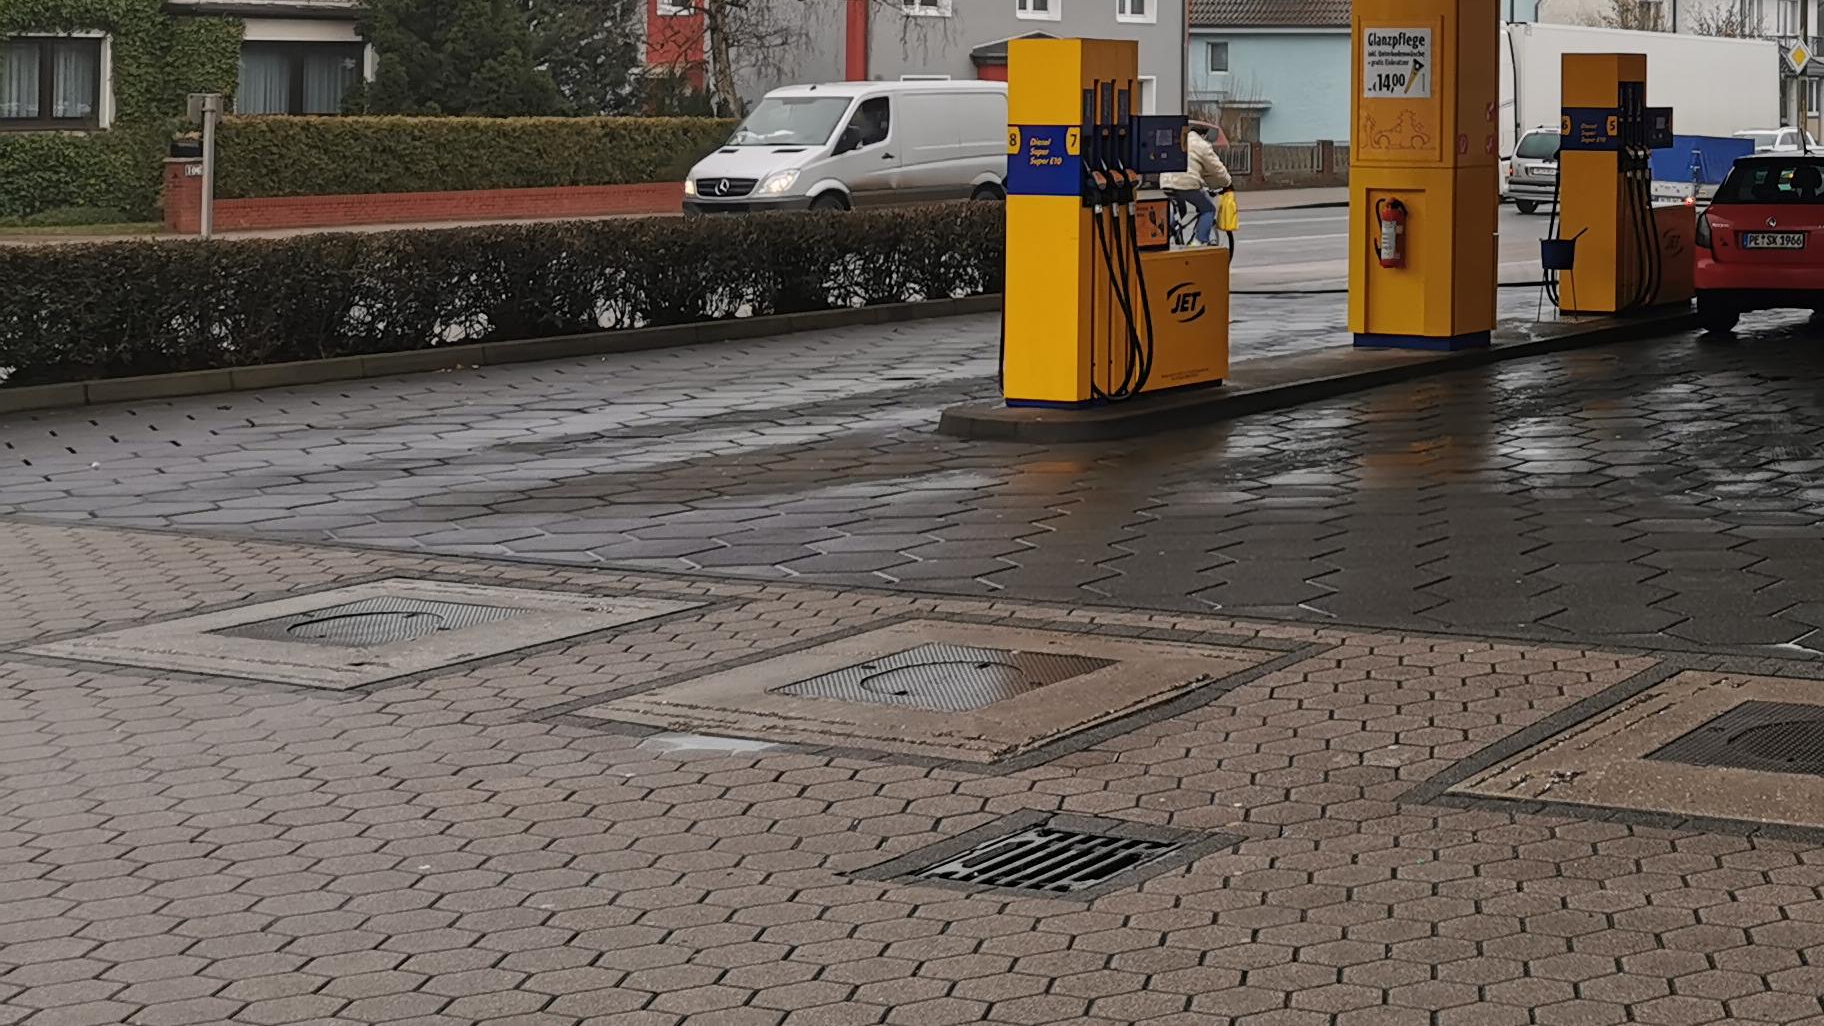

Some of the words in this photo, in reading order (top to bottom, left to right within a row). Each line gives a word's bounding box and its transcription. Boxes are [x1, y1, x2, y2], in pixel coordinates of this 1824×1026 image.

[1368, 32, 1425, 49] Glanzpflege
[1609, 119, 1616, 130] 5
[1009, 133, 1017, 146] 8
[1029, 137, 1051, 147] Diesel
[1070, 134, 1077, 147] 7
[1029, 148, 1049, 157] Super
[1029, 157, 1049, 167] Super
[1749, 235, 1760, 245] PE
[1780, 234, 1802, 246] 1966
[1171, 291, 1202, 314] JET
